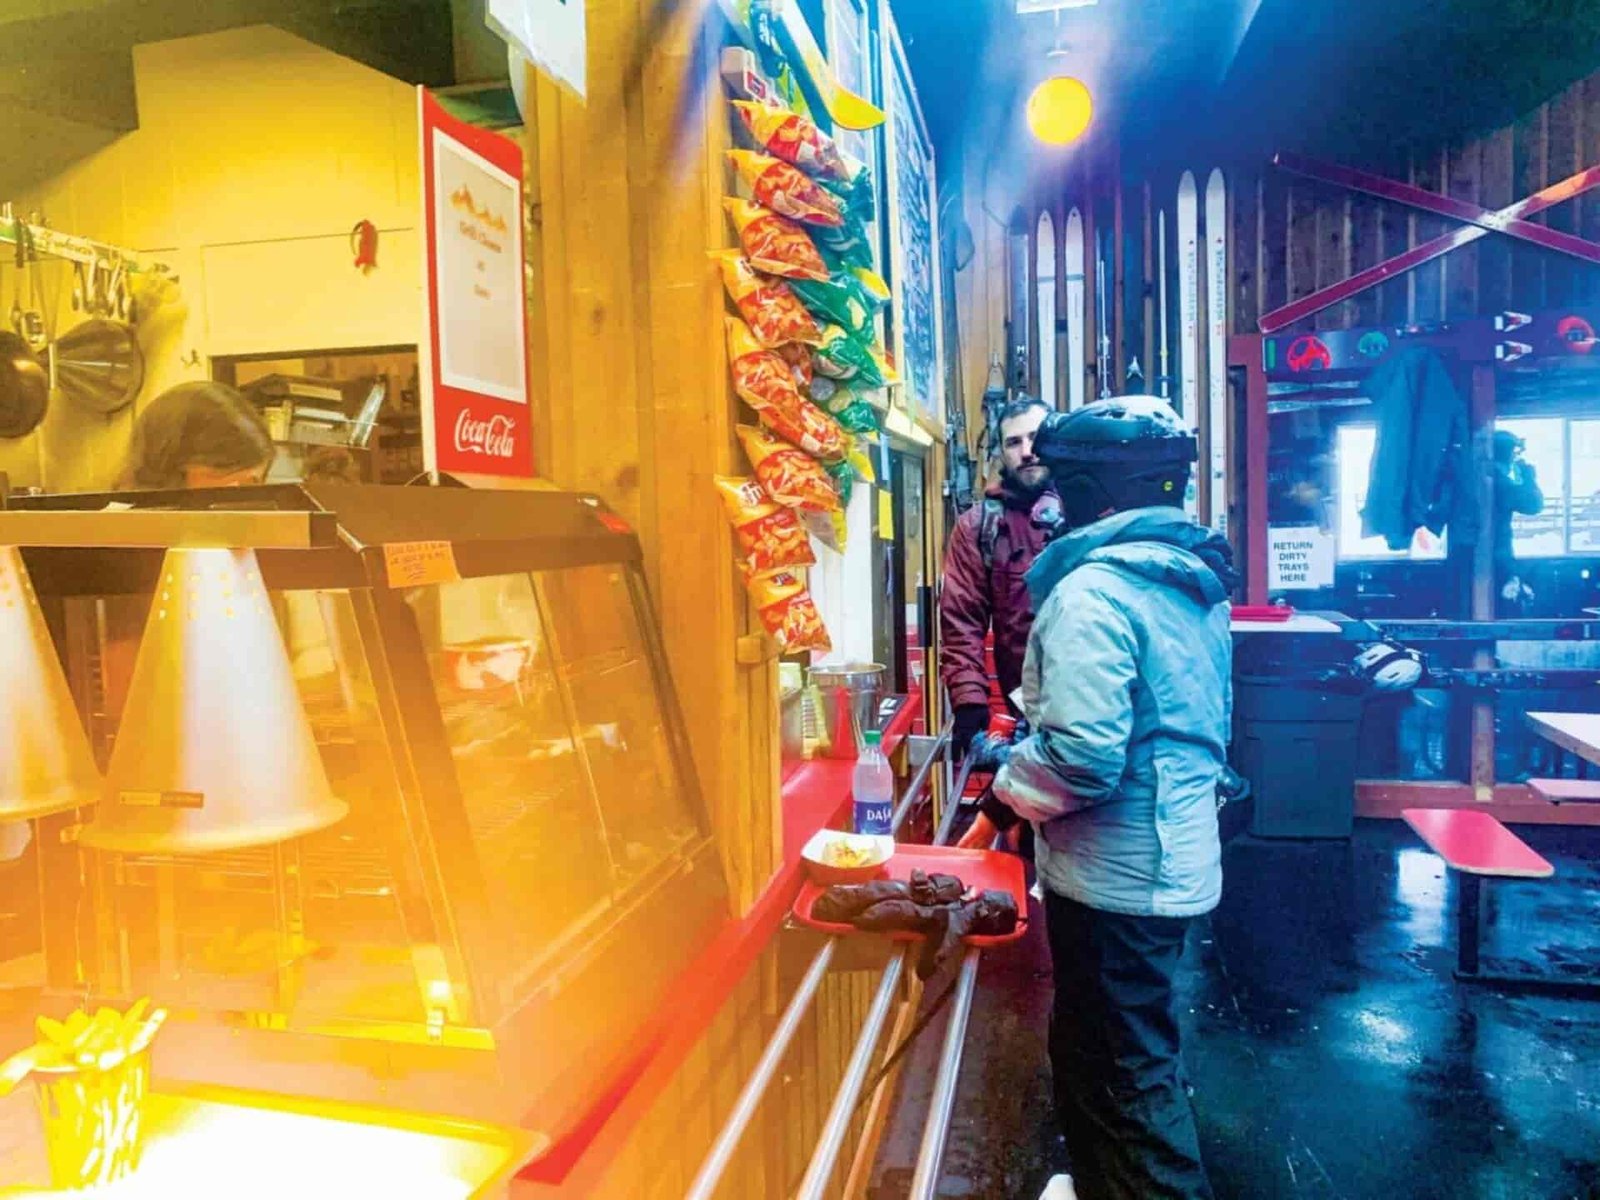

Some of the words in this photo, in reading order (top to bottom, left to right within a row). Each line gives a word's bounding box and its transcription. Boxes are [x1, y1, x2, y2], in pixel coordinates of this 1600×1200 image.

[1273, 541, 1313, 551] RETURN
[1279, 552, 1307, 561] DIRTY
[1278, 562, 1310, 572] TRAYS
[1280, 573, 1307, 582] HERE
